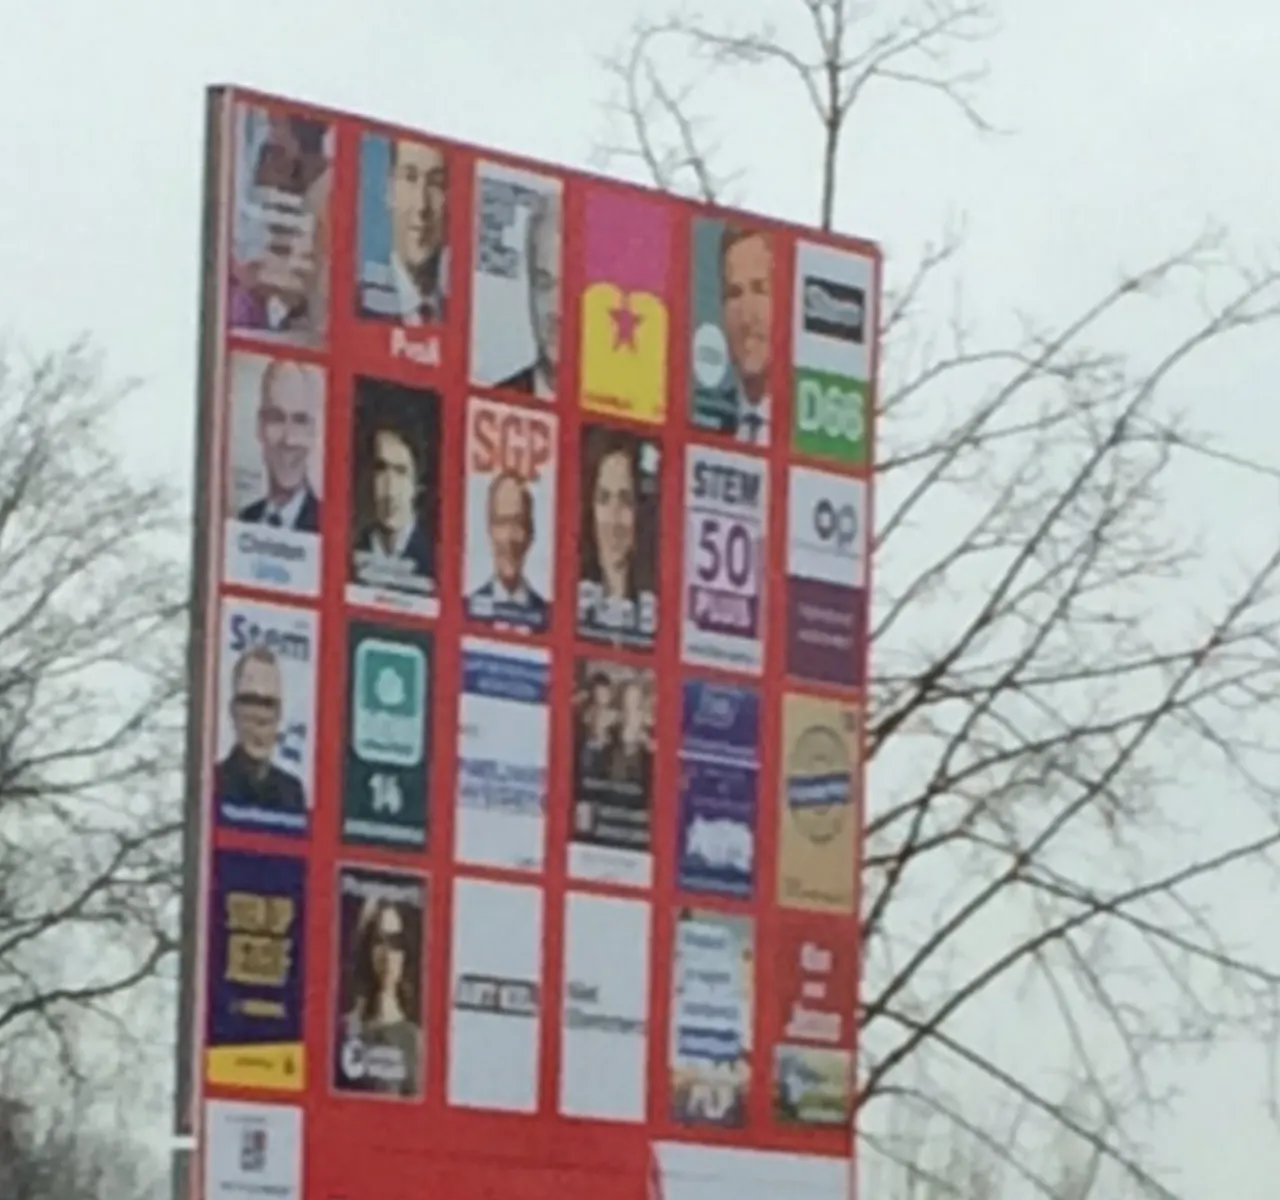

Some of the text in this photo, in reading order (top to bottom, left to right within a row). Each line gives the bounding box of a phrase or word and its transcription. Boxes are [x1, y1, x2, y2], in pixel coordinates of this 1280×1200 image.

[797, 379, 864, 440] D66
[473, 409, 550, 483] SGP
[693, 461, 761, 506] STEM
[697, 520, 752, 587] 50
